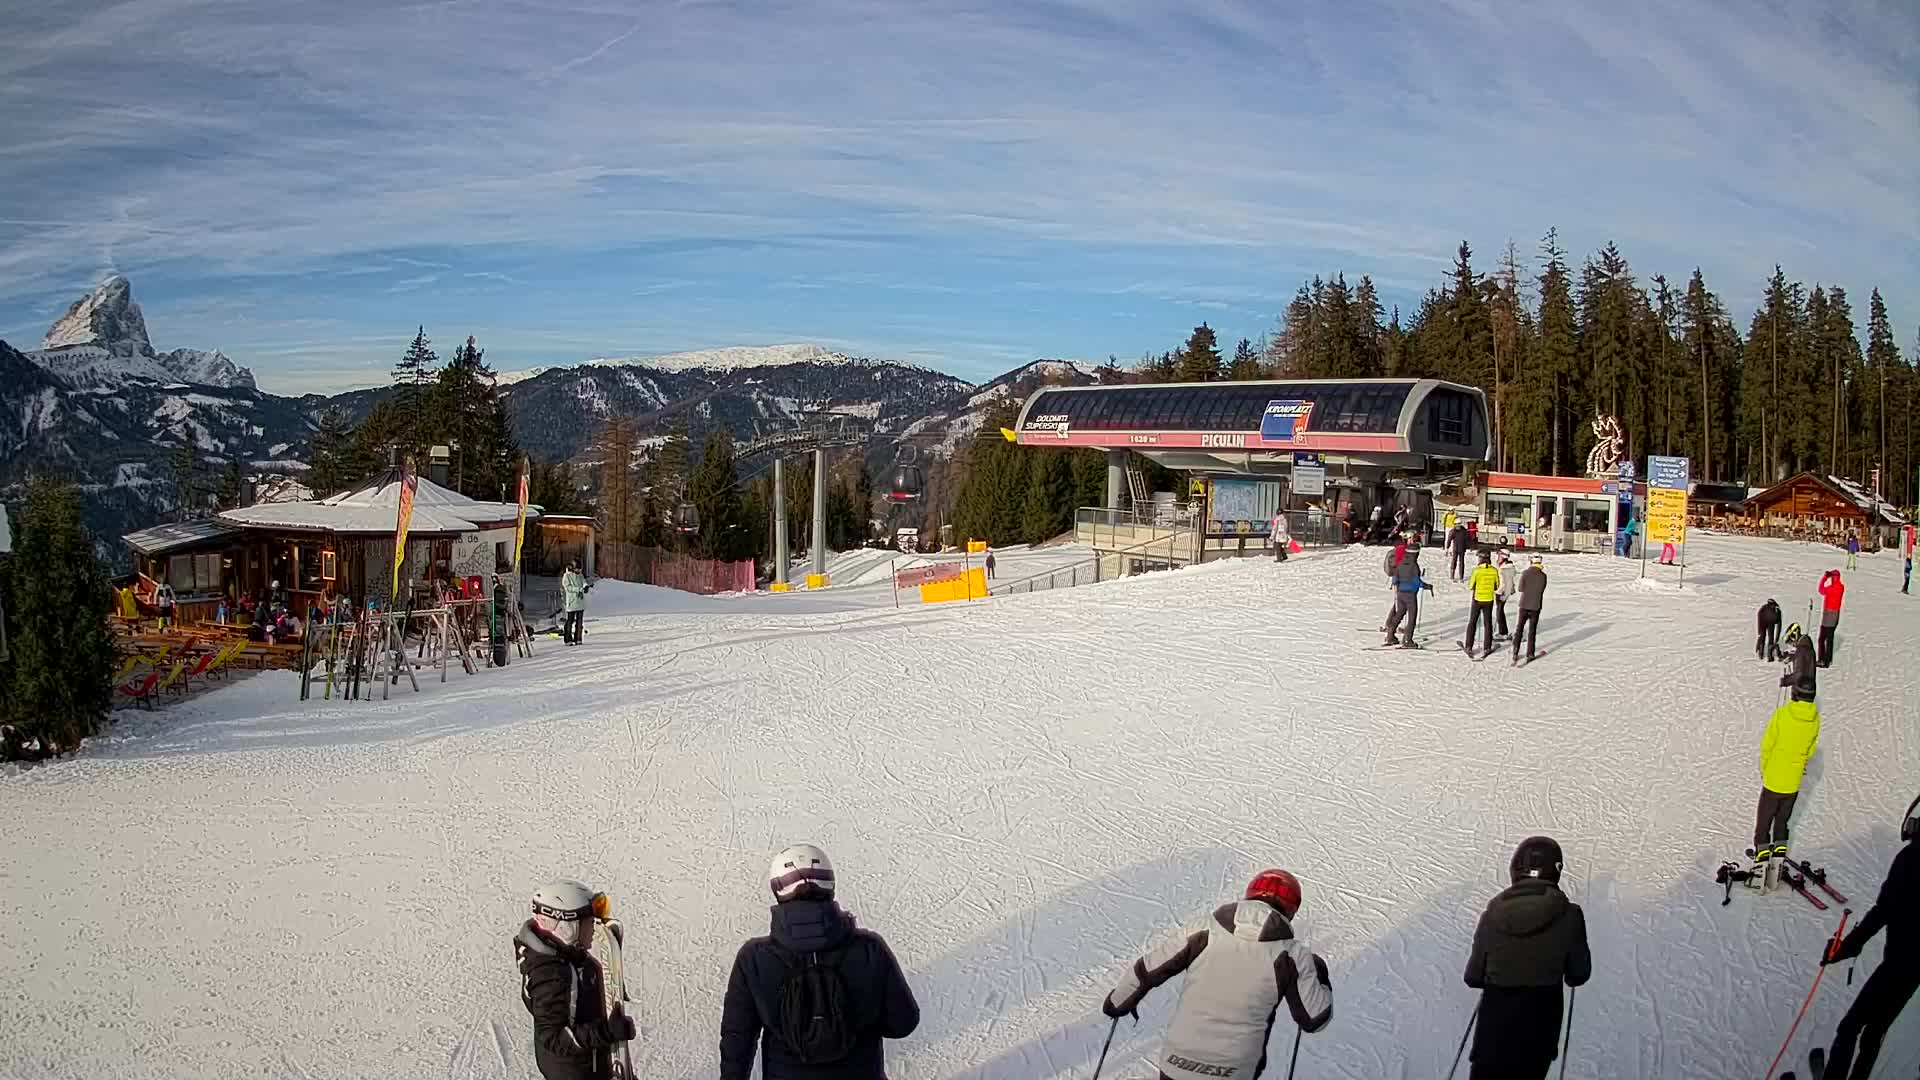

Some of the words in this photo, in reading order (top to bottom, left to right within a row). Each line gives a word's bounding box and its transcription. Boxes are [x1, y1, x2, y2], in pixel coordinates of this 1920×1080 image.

[1201, 434, 1245, 447] PICULIN
[541, 905, 577, 919] CMP
[1167, 1054, 1239, 1078] DAINESE
